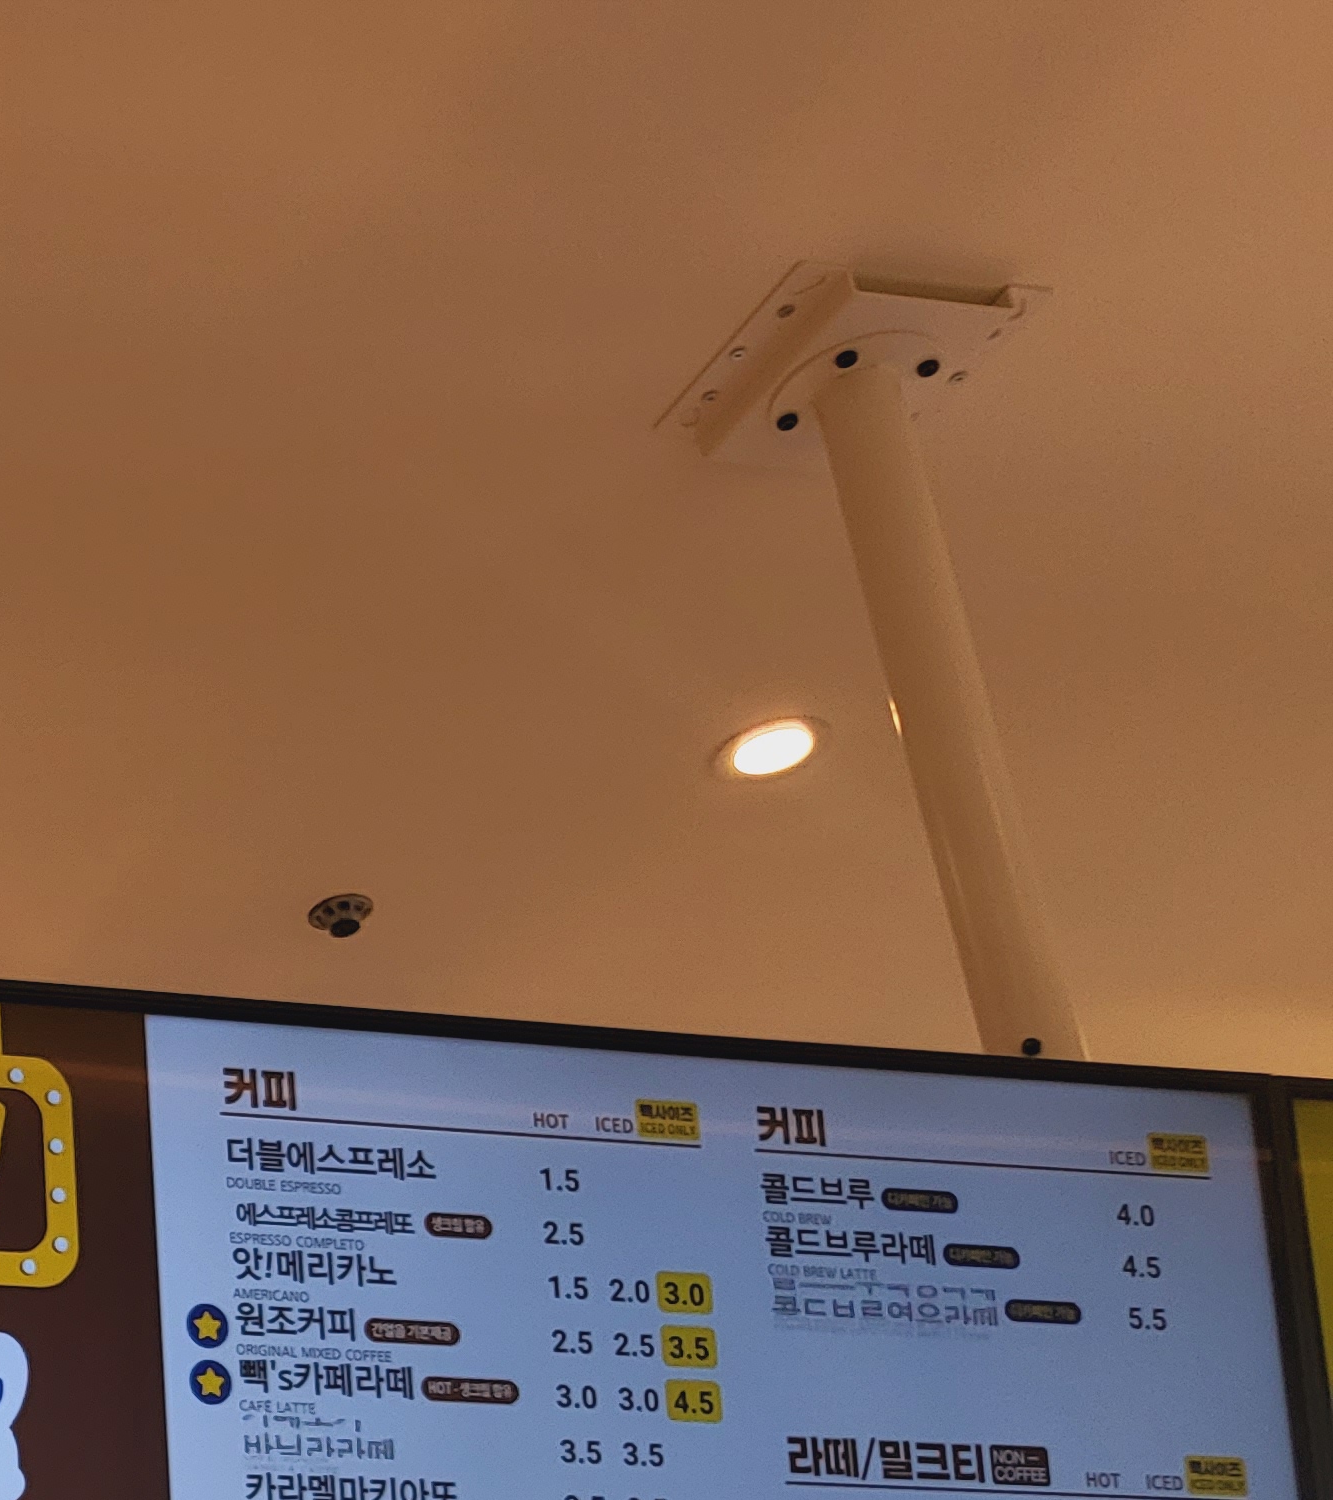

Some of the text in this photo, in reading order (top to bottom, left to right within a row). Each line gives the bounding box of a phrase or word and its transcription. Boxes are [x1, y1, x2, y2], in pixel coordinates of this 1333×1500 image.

[223, 1068, 296, 1110] 커피
[533, 1112, 633, 1133] HOT ICED
[756, 1106, 826, 1147] 커피
[227, 1137, 436, 1180] 더블에스프레소
[1109, 1151, 1145, 1166] ICED
[226, 1177, 341, 1195] DOUBLE ESPRESSO
[539, 1167, 580, 1193] 1.5
[760, 1173, 874, 1209] 콜드브루
[763, 1211, 831, 1225] COLD BREW
[1117, 1204, 1155, 1227] 4.0
[543, 1221, 584, 1246] 2.5
[765, 1226, 935, 1266] 콜드브루라떼
[233, 1248, 397, 1287] 앗!메리카노
[1122, 1255, 1160, 1278] 4.5
[234, 1288, 309, 1302] AMERICANO
[547, 1274, 705, 1305] 1.5 2.0 3.0
[235, 1303, 355, 1341] 원조커피
[1128, 1307, 1167, 1331] 5.5
[555, 1384, 714, 1414] 3.0 3.0 4.5
[786, 1436, 984, 1483] 라떼/밀크티
[995, 1466, 1048, 1483] COFFEE
[1085, 1472, 1120, 1489] HOT
[1145, 1474, 1183, 1491] ICED
